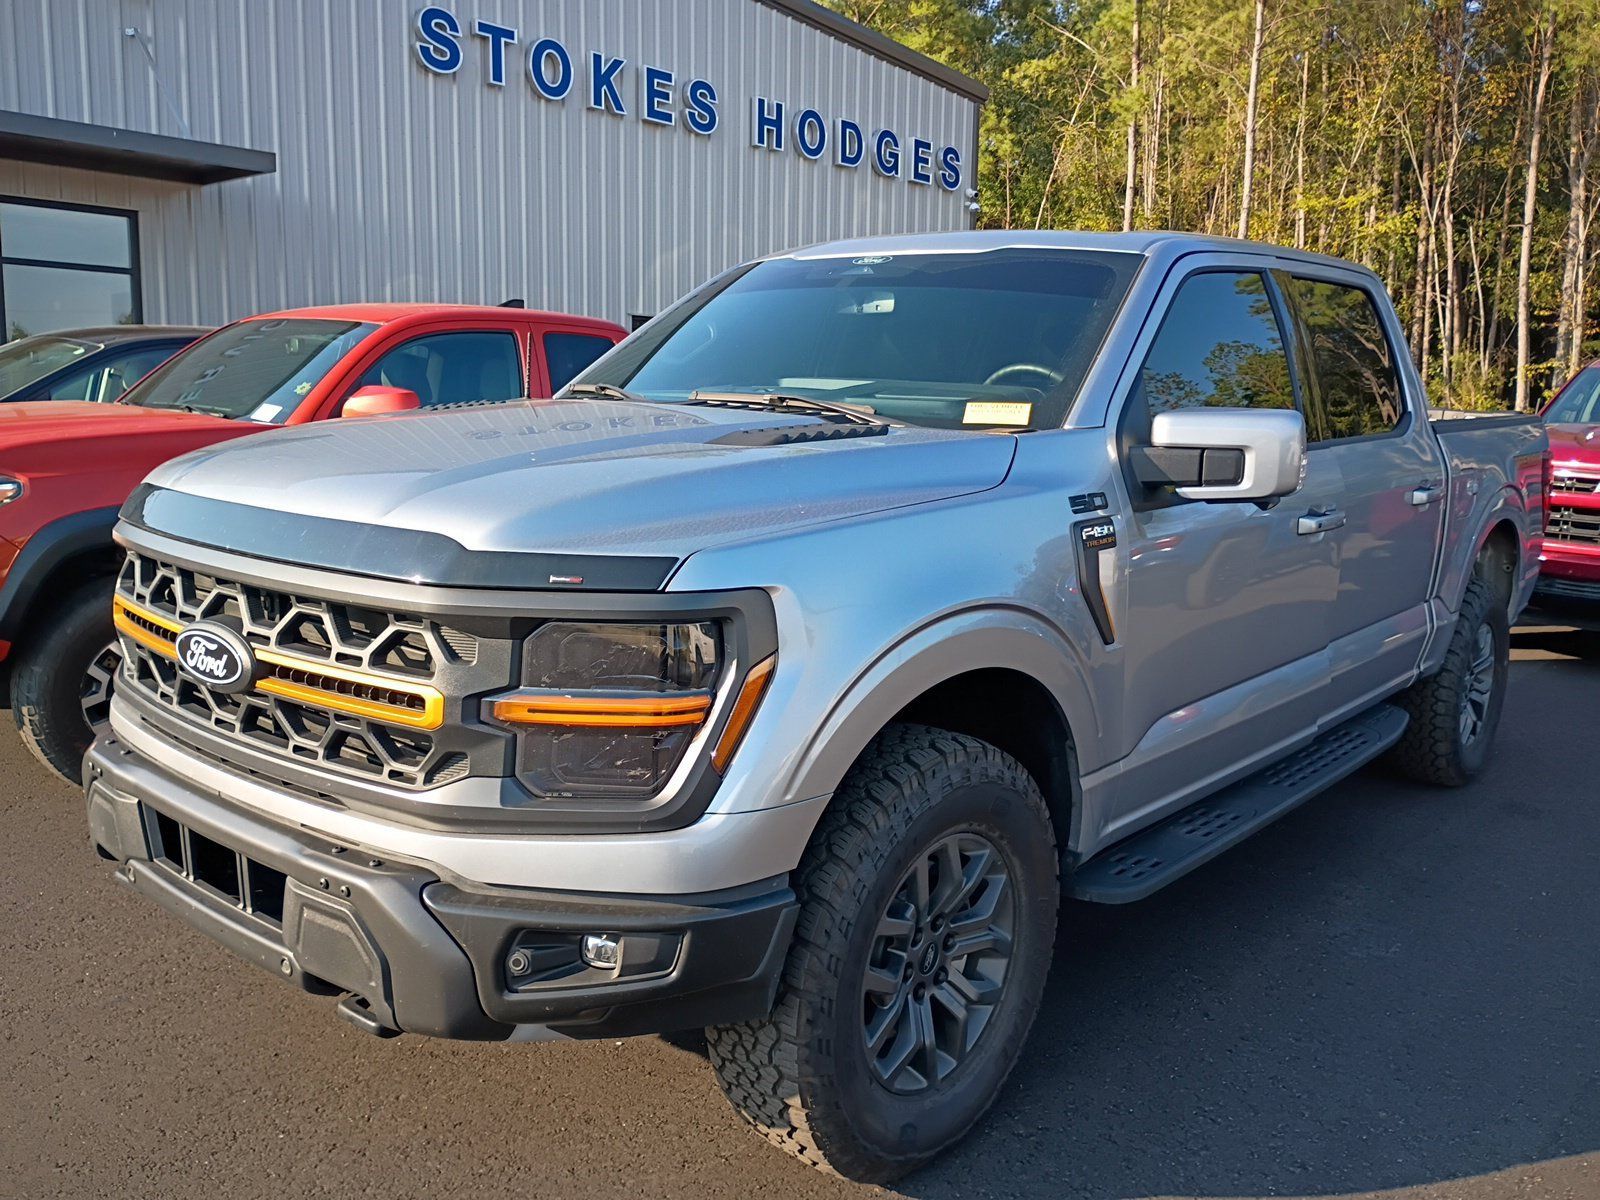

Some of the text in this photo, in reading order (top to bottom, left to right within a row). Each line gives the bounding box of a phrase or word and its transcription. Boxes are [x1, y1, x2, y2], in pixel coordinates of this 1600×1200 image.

[415, 6, 962, 191] STOKES HODGES
[1086, 536, 1116, 547] TREMOR
[186, 636, 229, 678] Ford
